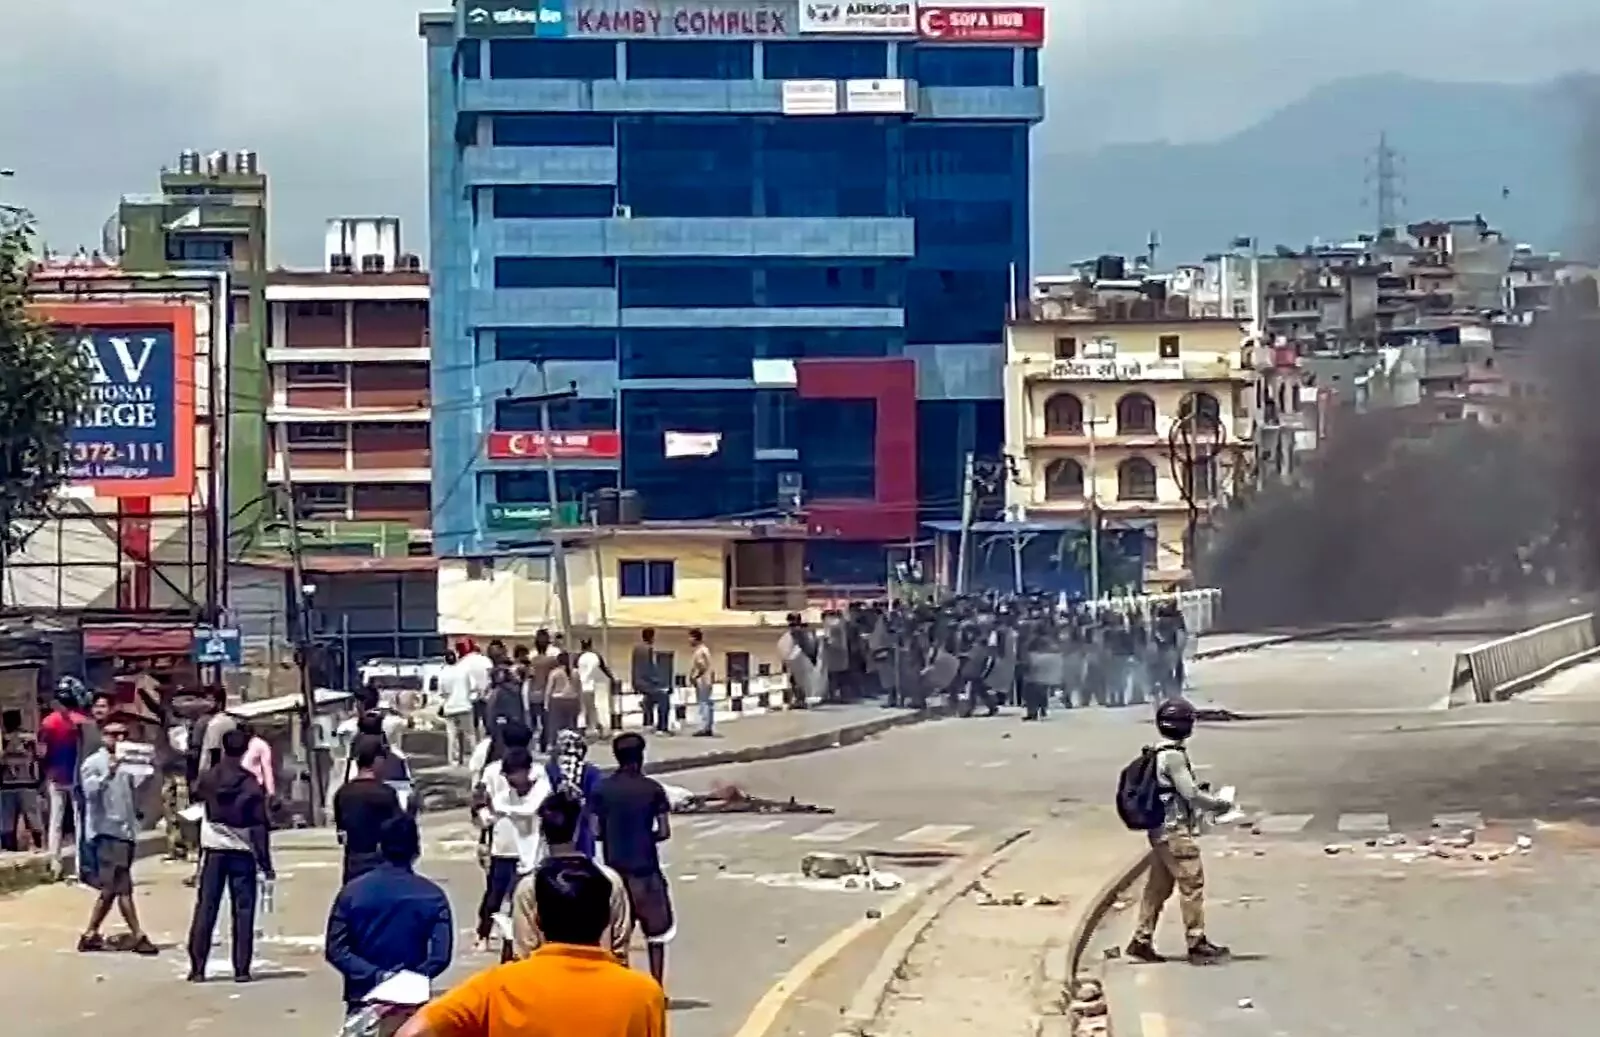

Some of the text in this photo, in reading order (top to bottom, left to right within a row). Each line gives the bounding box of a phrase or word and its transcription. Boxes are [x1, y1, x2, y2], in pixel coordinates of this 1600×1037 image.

[576, 8, 662, 33] KAMBY
[674, 10, 787, 35] COMPLEX
[76, 336, 156, 384] AV
[86, 384, 153, 402] TIONAL
[74, 402, 156, 428] LEGE
[64, 441, 165, 463] 372-111
